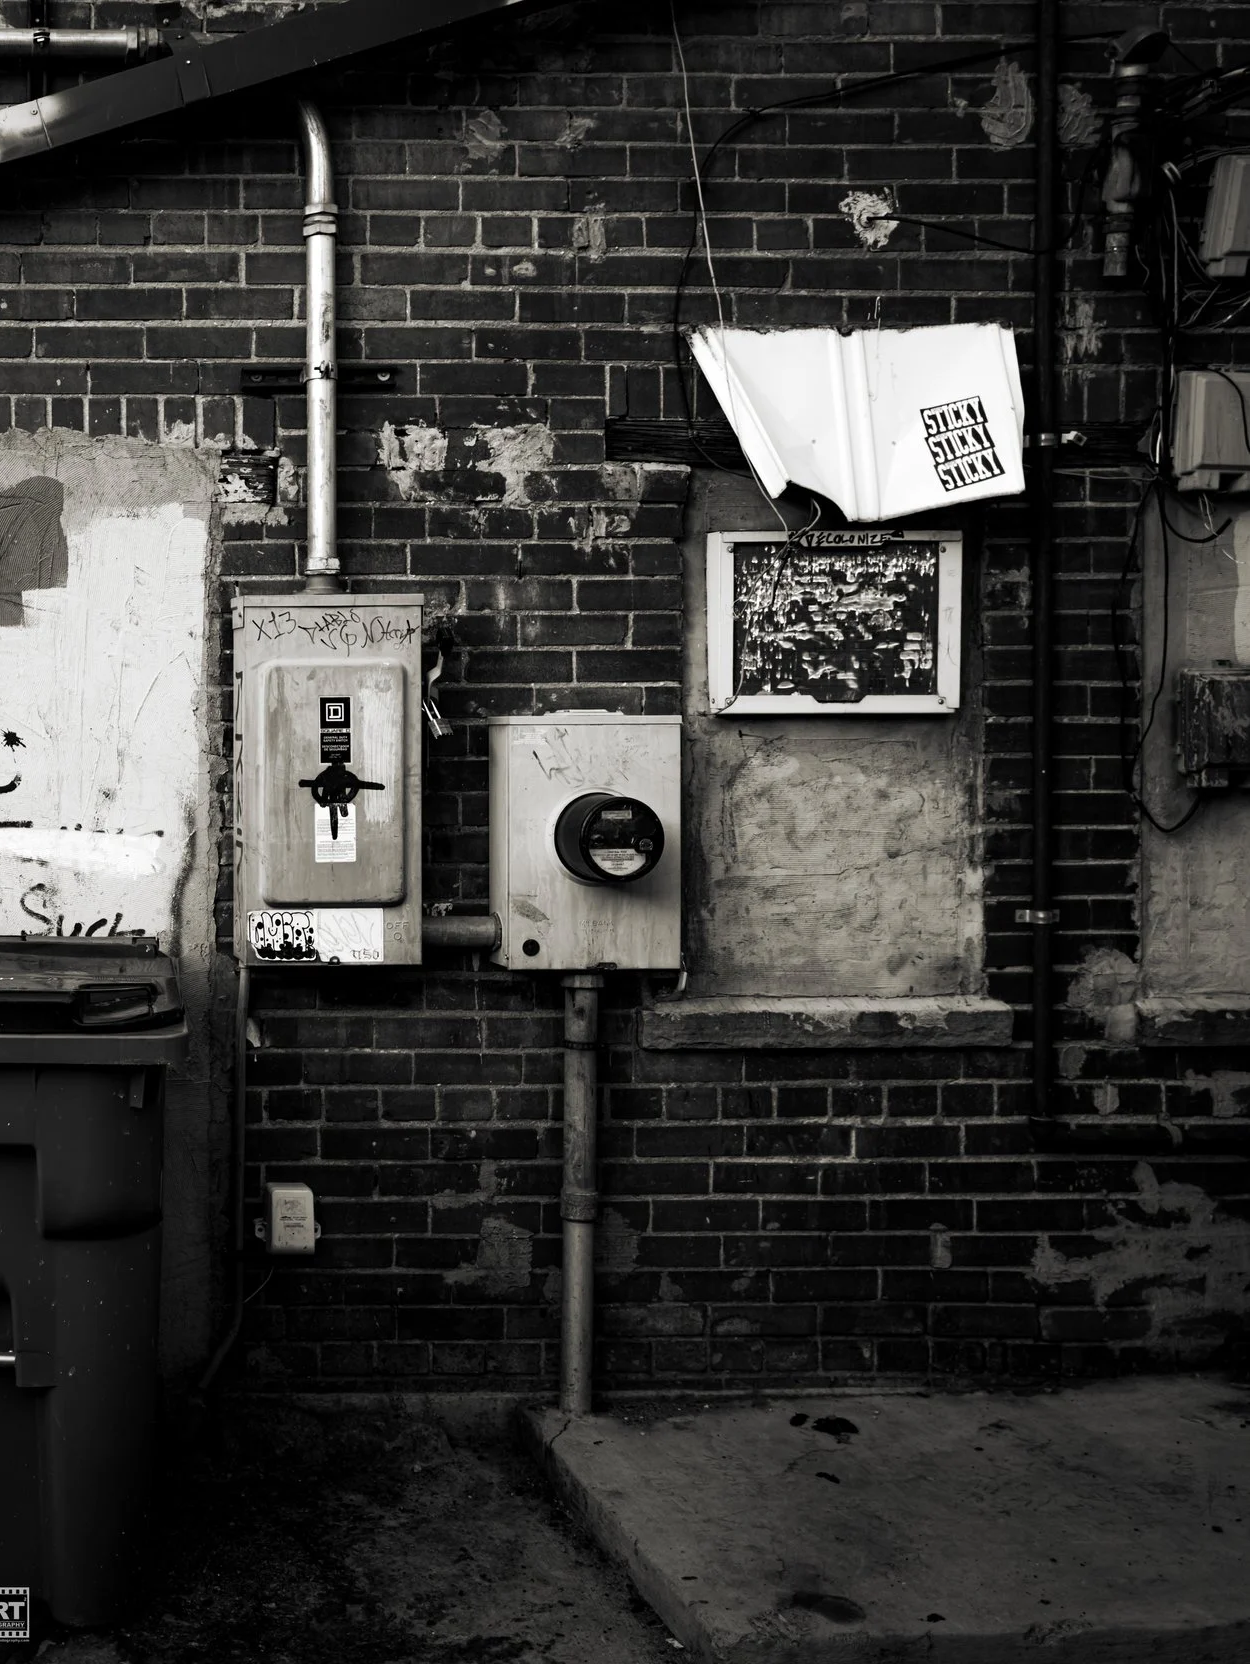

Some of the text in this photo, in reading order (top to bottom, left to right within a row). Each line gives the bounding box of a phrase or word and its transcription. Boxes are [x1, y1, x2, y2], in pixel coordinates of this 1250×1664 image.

[922, 397, 985, 435] STICKY
[927, 423, 991, 463] STICKY
[937, 447, 1001, 490] STICKY
